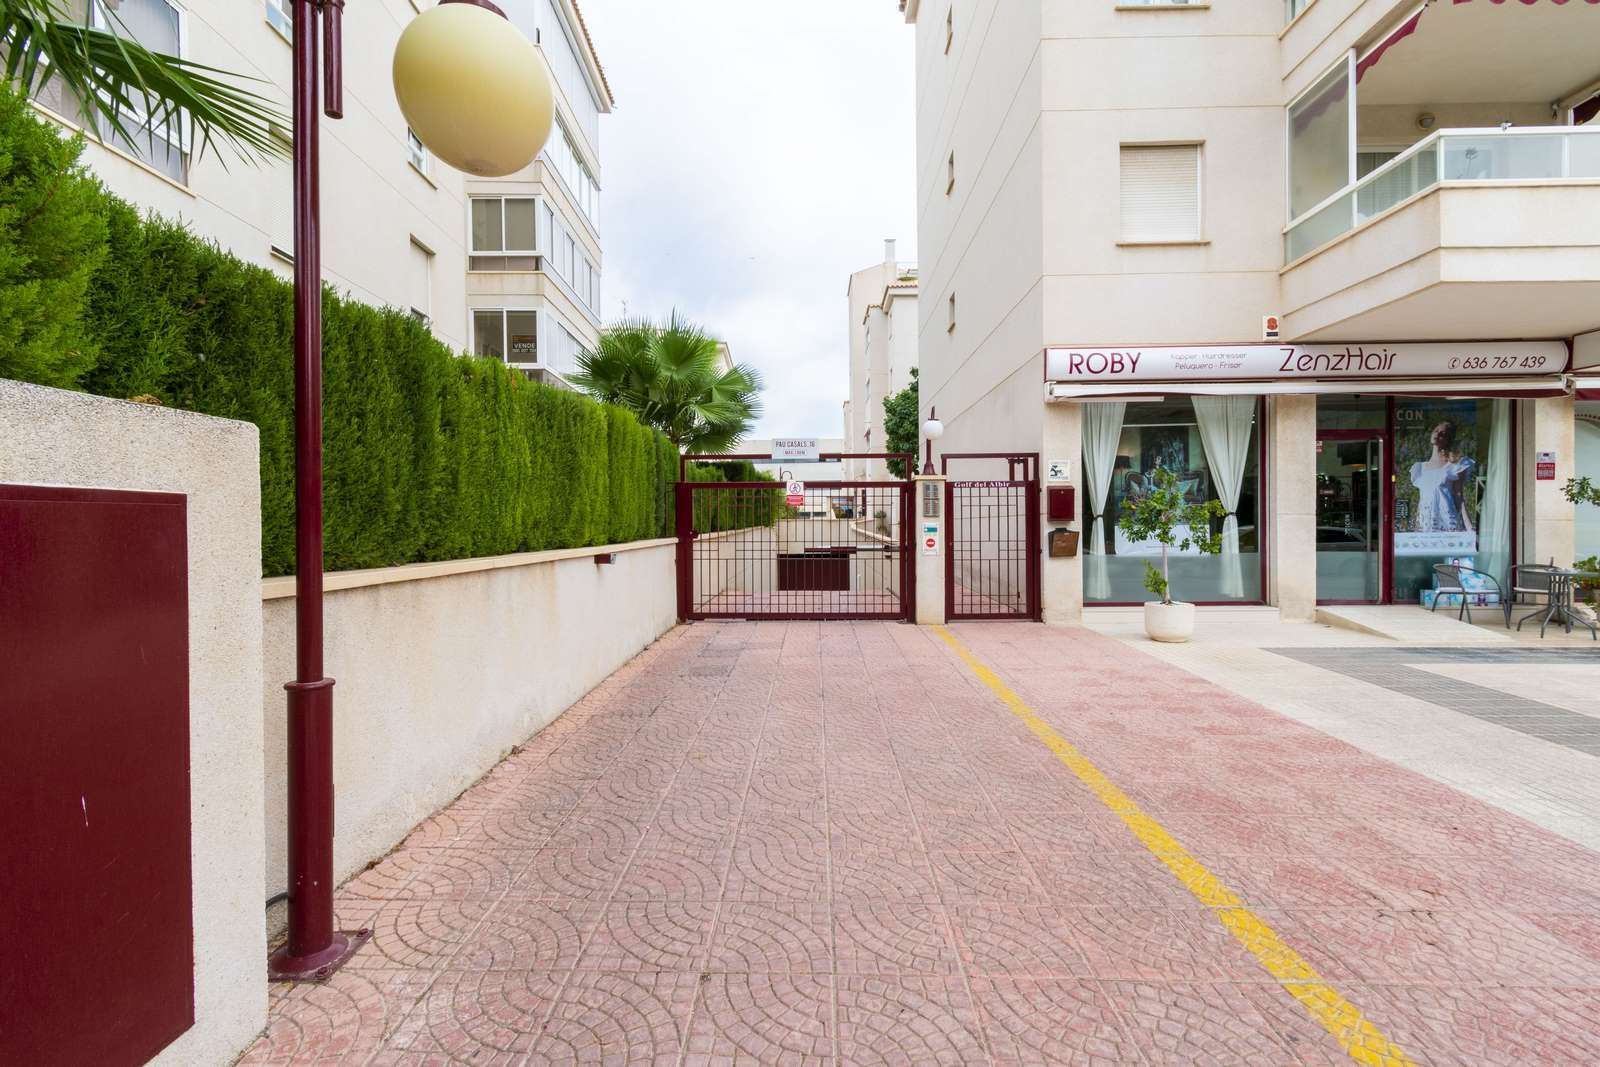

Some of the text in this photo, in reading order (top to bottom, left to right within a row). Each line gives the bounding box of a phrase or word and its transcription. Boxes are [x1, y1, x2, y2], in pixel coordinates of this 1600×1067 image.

[1068, 352, 1142, 375] ROBY
[1174, 361, 1214, 371] Peluquero
[1278, 346, 1397, 372] ZenzHair
[1462, 355, 1546, 369] 636 767 439
[775, 440, 786, 448] PAU
